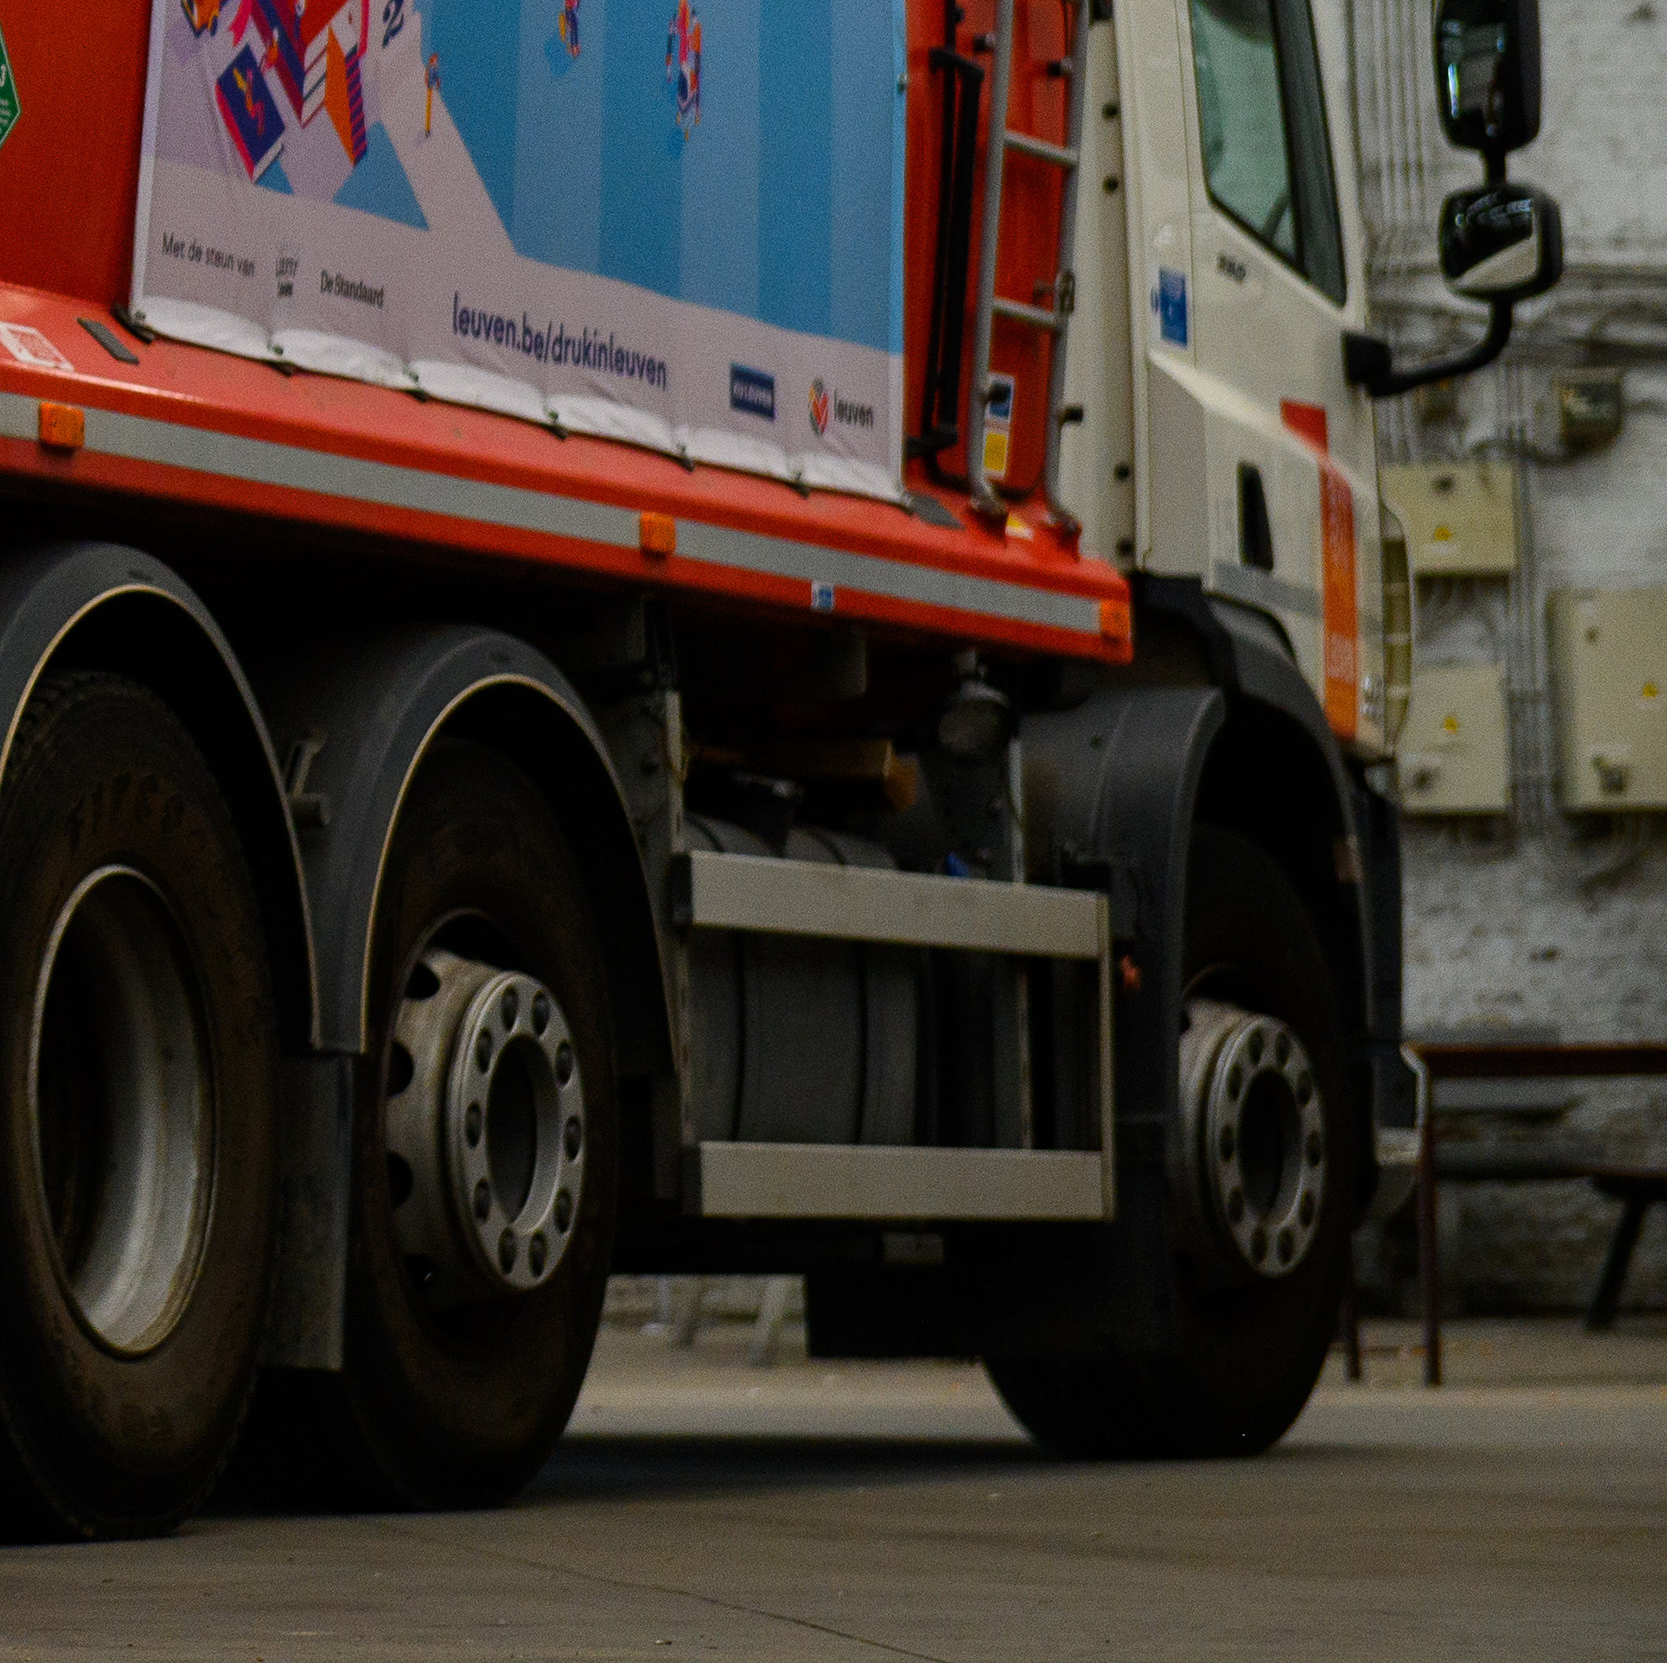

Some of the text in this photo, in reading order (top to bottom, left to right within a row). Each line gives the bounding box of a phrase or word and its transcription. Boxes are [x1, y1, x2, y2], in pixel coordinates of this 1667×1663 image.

[162, 232, 185, 259] Met
[187, 238, 203, 263] de
[237, 256, 256, 278] van
[320, 269, 334, 295] De
[453, 290, 669, 392] leuven.be/drukinleuven
[834, 389, 875, 431] leuven
